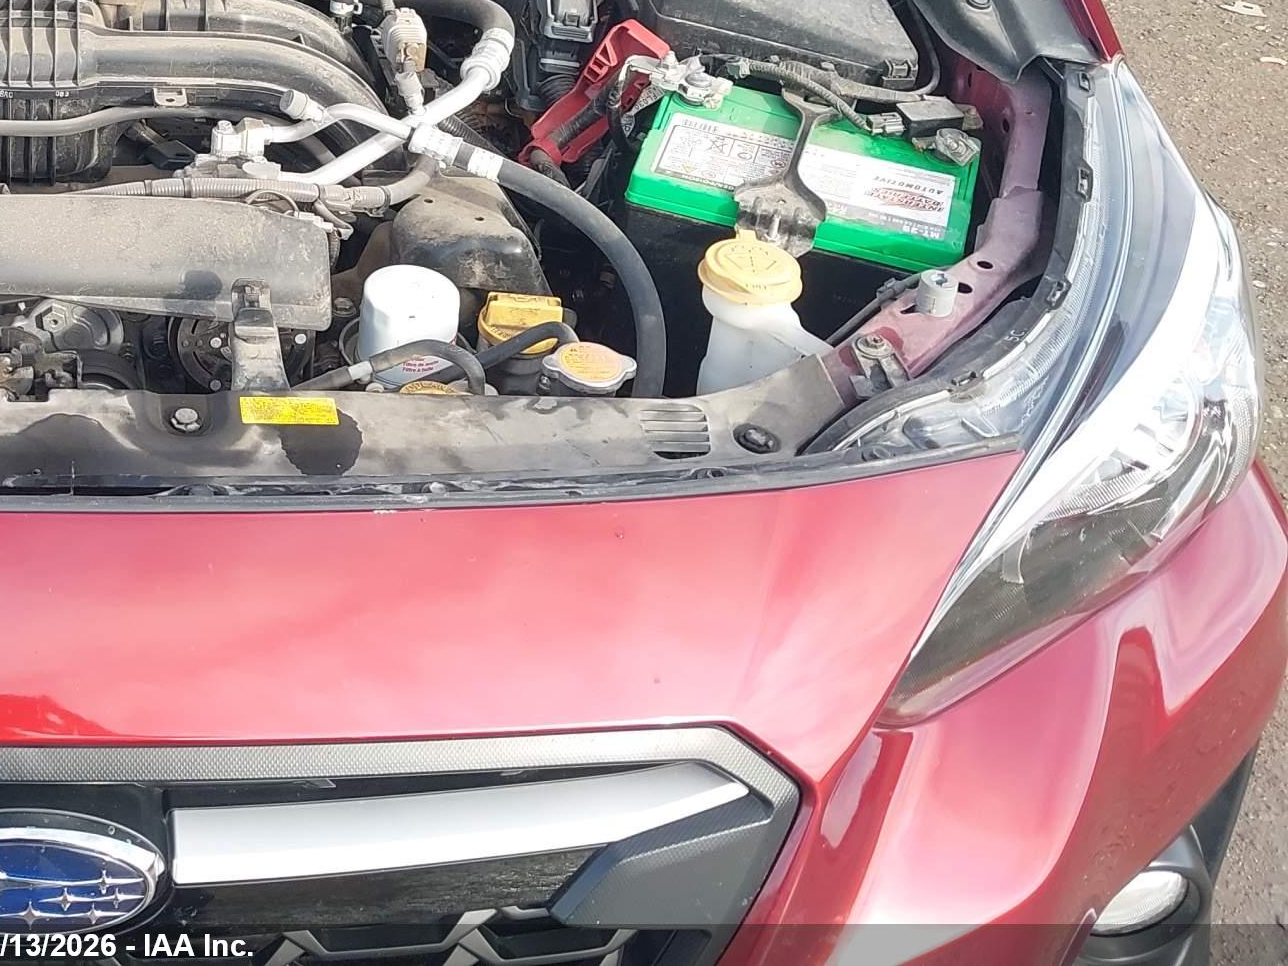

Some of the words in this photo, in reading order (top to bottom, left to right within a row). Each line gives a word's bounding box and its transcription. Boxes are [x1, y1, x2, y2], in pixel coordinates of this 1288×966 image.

[871, 175, 944, 195] AUTOMOTIVE
[869, 192, 945, 212] INTERSTATE
[871, 188, 944, 206] BATTERIES
